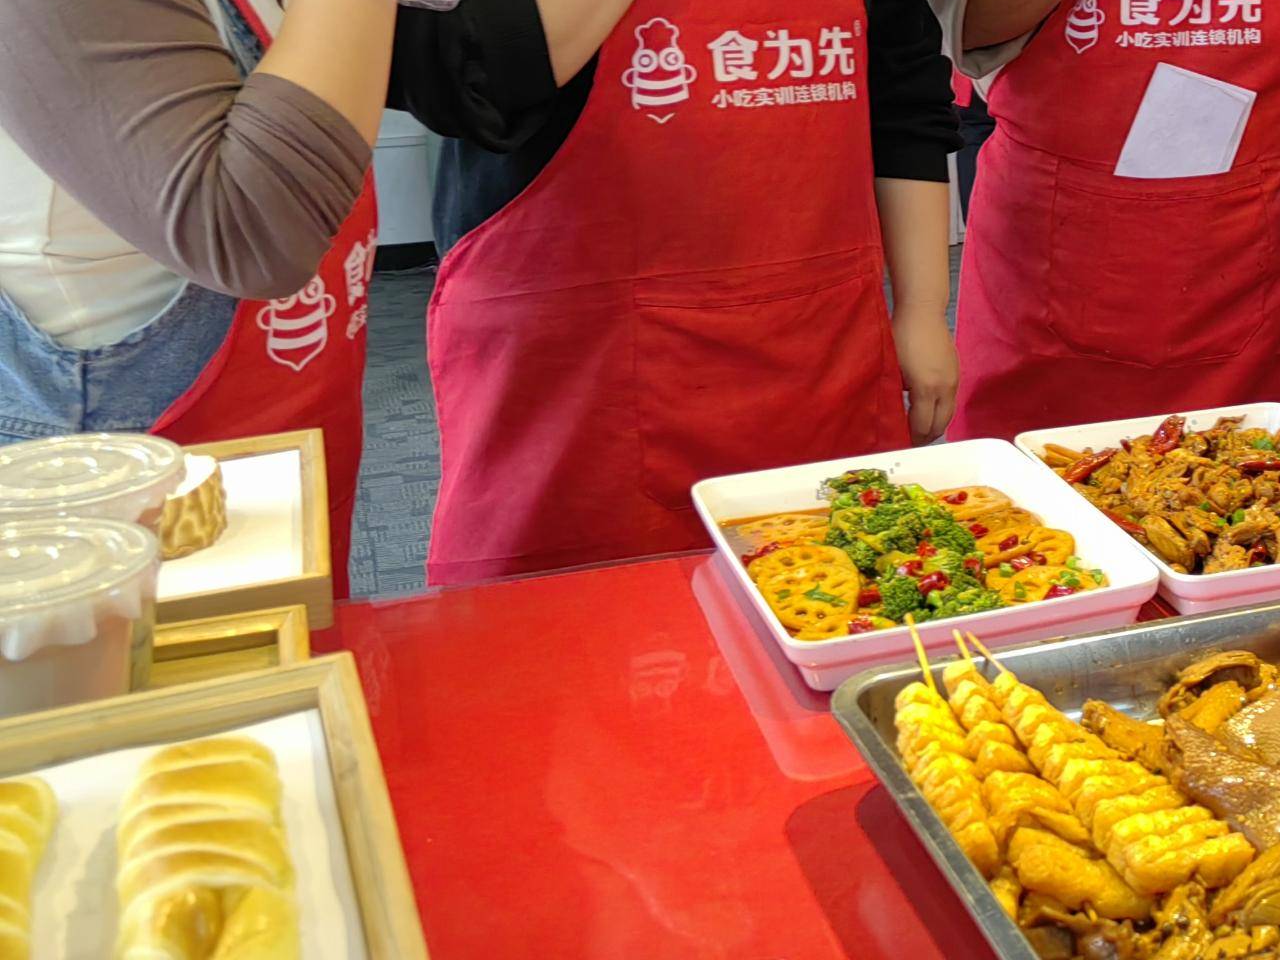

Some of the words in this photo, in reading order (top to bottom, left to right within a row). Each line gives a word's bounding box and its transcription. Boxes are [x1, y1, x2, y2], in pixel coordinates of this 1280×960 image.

[1115, 27, 1261, 49] 小吃实训连锁机构
[707, 26, 856, 83] 食为先
[711, 81, 857, 109] 小吃实训连锁机构
